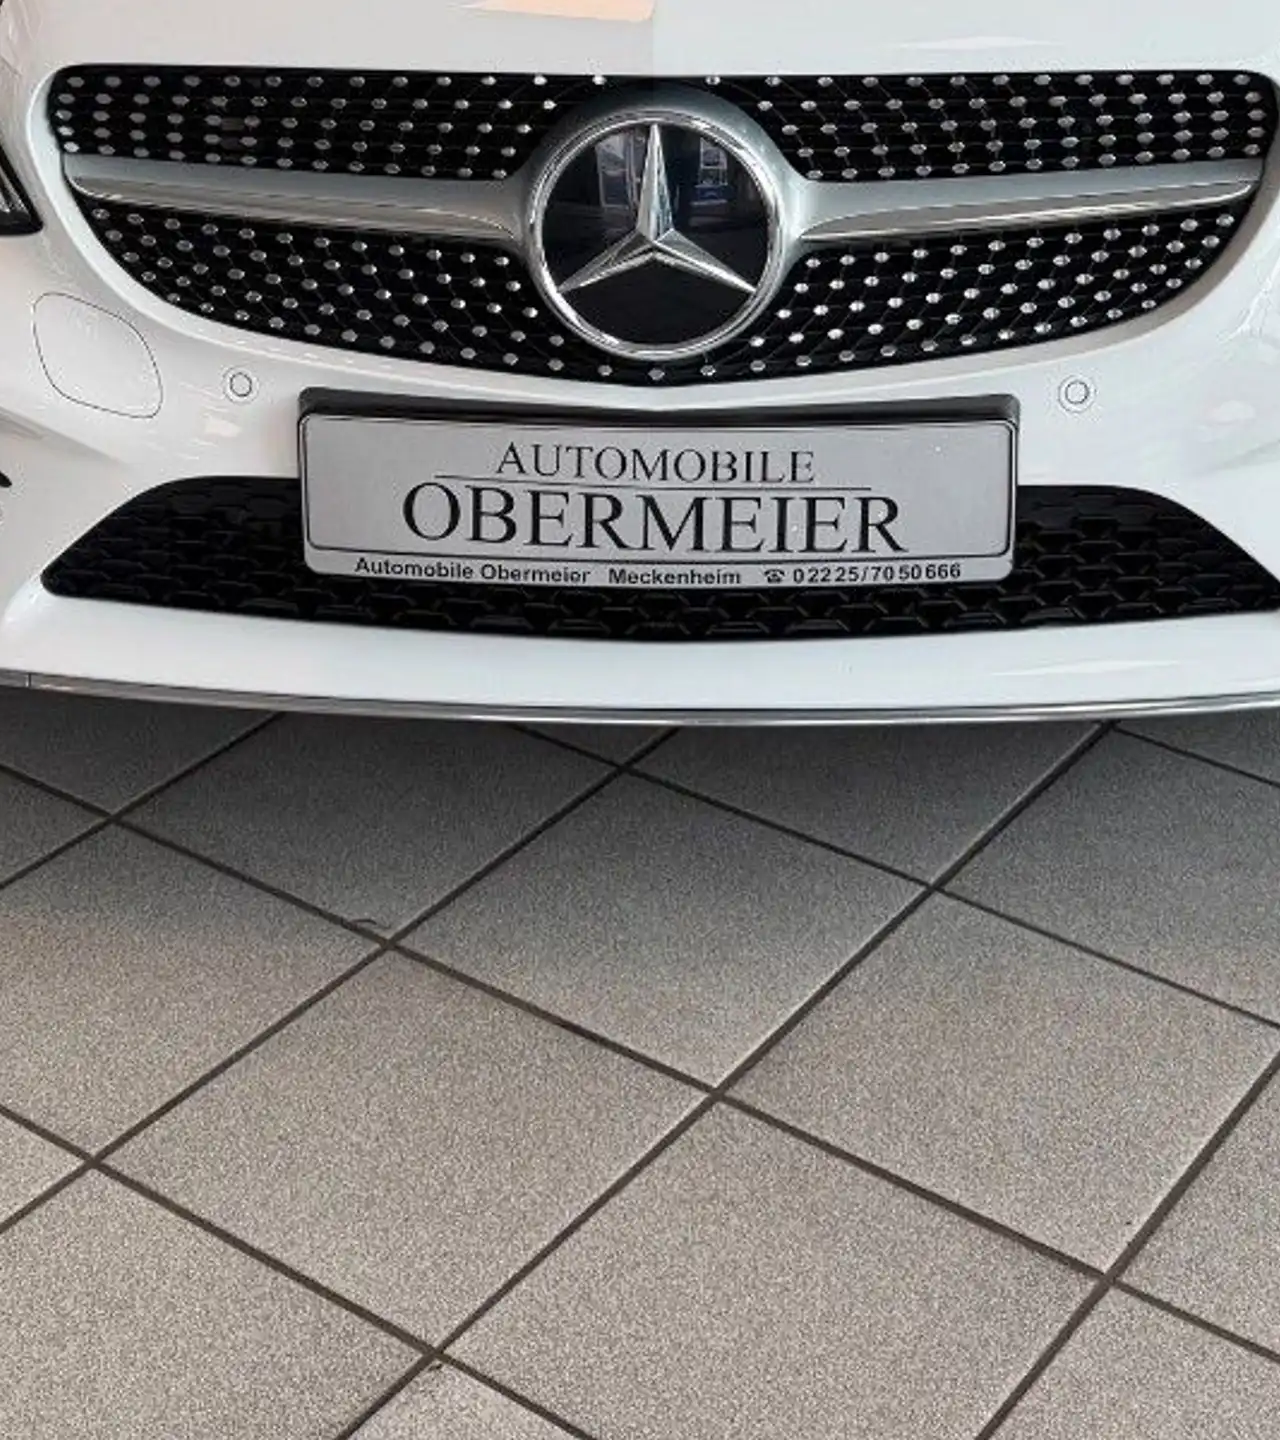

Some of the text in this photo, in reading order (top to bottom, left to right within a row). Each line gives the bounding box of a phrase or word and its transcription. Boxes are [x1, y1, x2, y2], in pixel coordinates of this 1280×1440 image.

[495, 441, 815, 483] AUTOMOBILE
[403, 482, 909, 553] OBERMEIER
[355, 557, 473, 579] Automobile
[481, 564, 590, 583] Obermeier
[609, 567, 741, 584] Meckenheim
